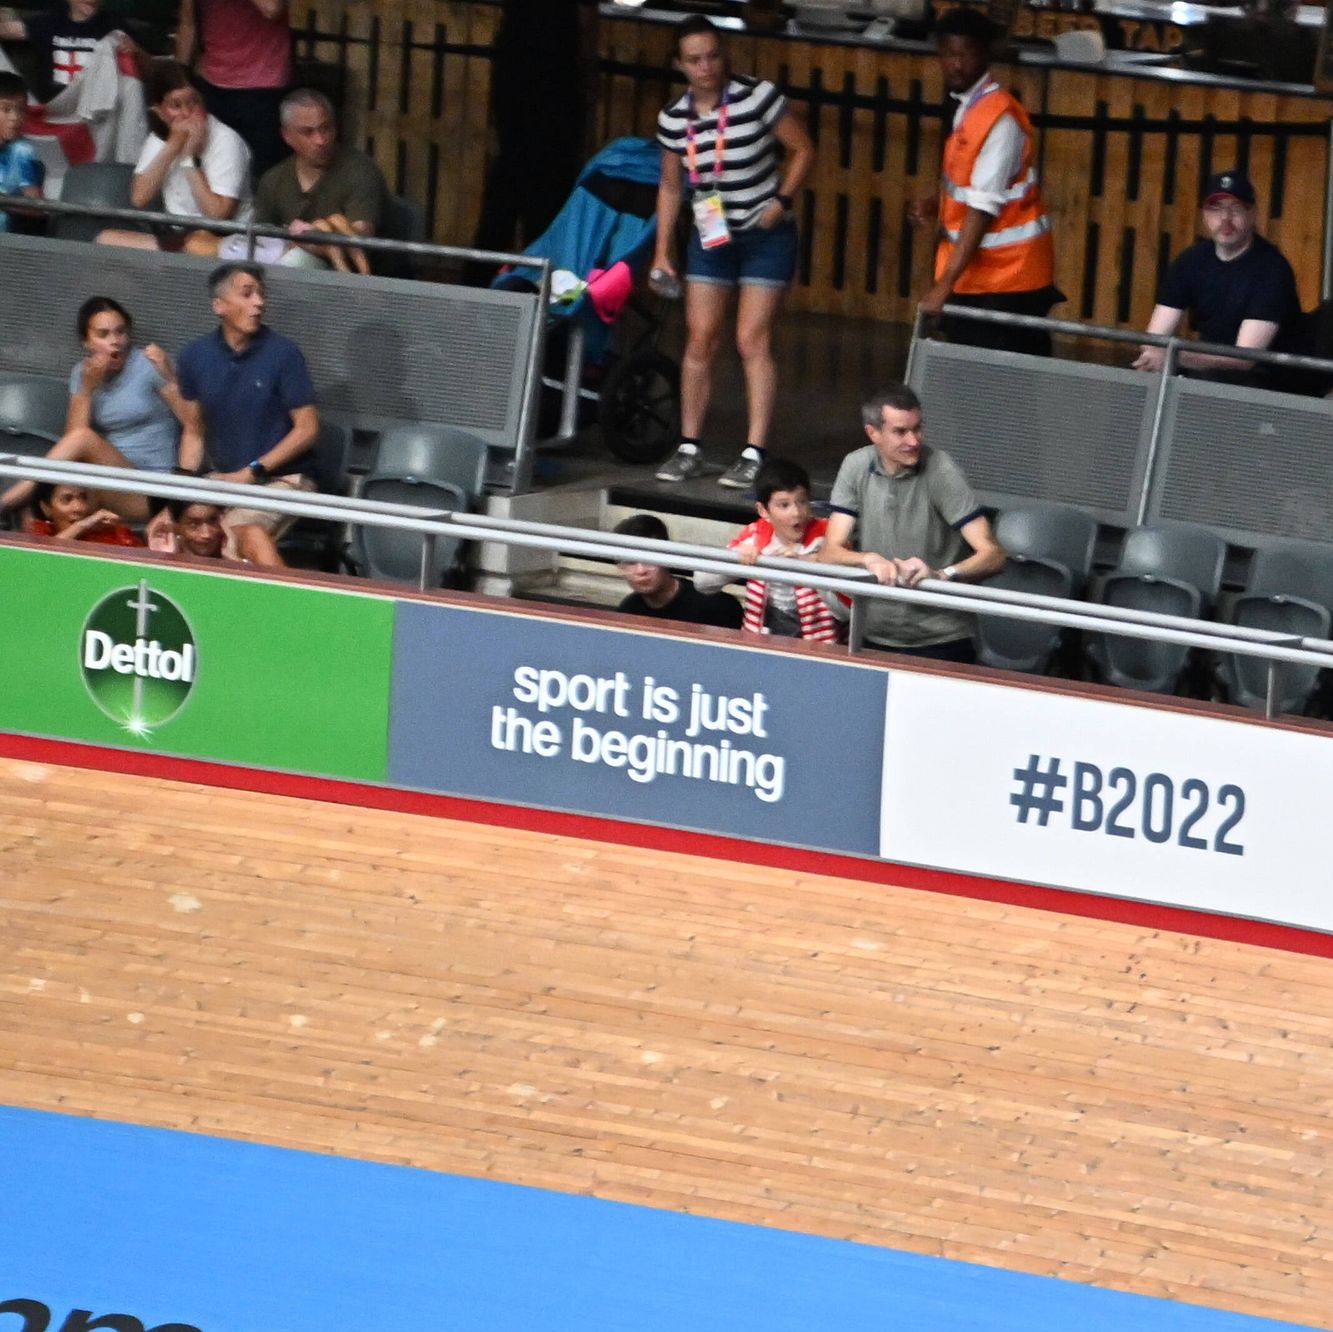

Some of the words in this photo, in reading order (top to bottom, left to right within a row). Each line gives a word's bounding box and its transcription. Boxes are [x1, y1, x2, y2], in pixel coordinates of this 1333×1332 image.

[83, 629, 193, 683] Dettol
[513, 663, 628, 718] sport
[642, 672, 679, 725] is
[686, 683, 767, 739] just
[491, 705, 561, 758] the
[571, 716, 785, 804] beginning
[1010, 753, 1246, 857] #B2022
